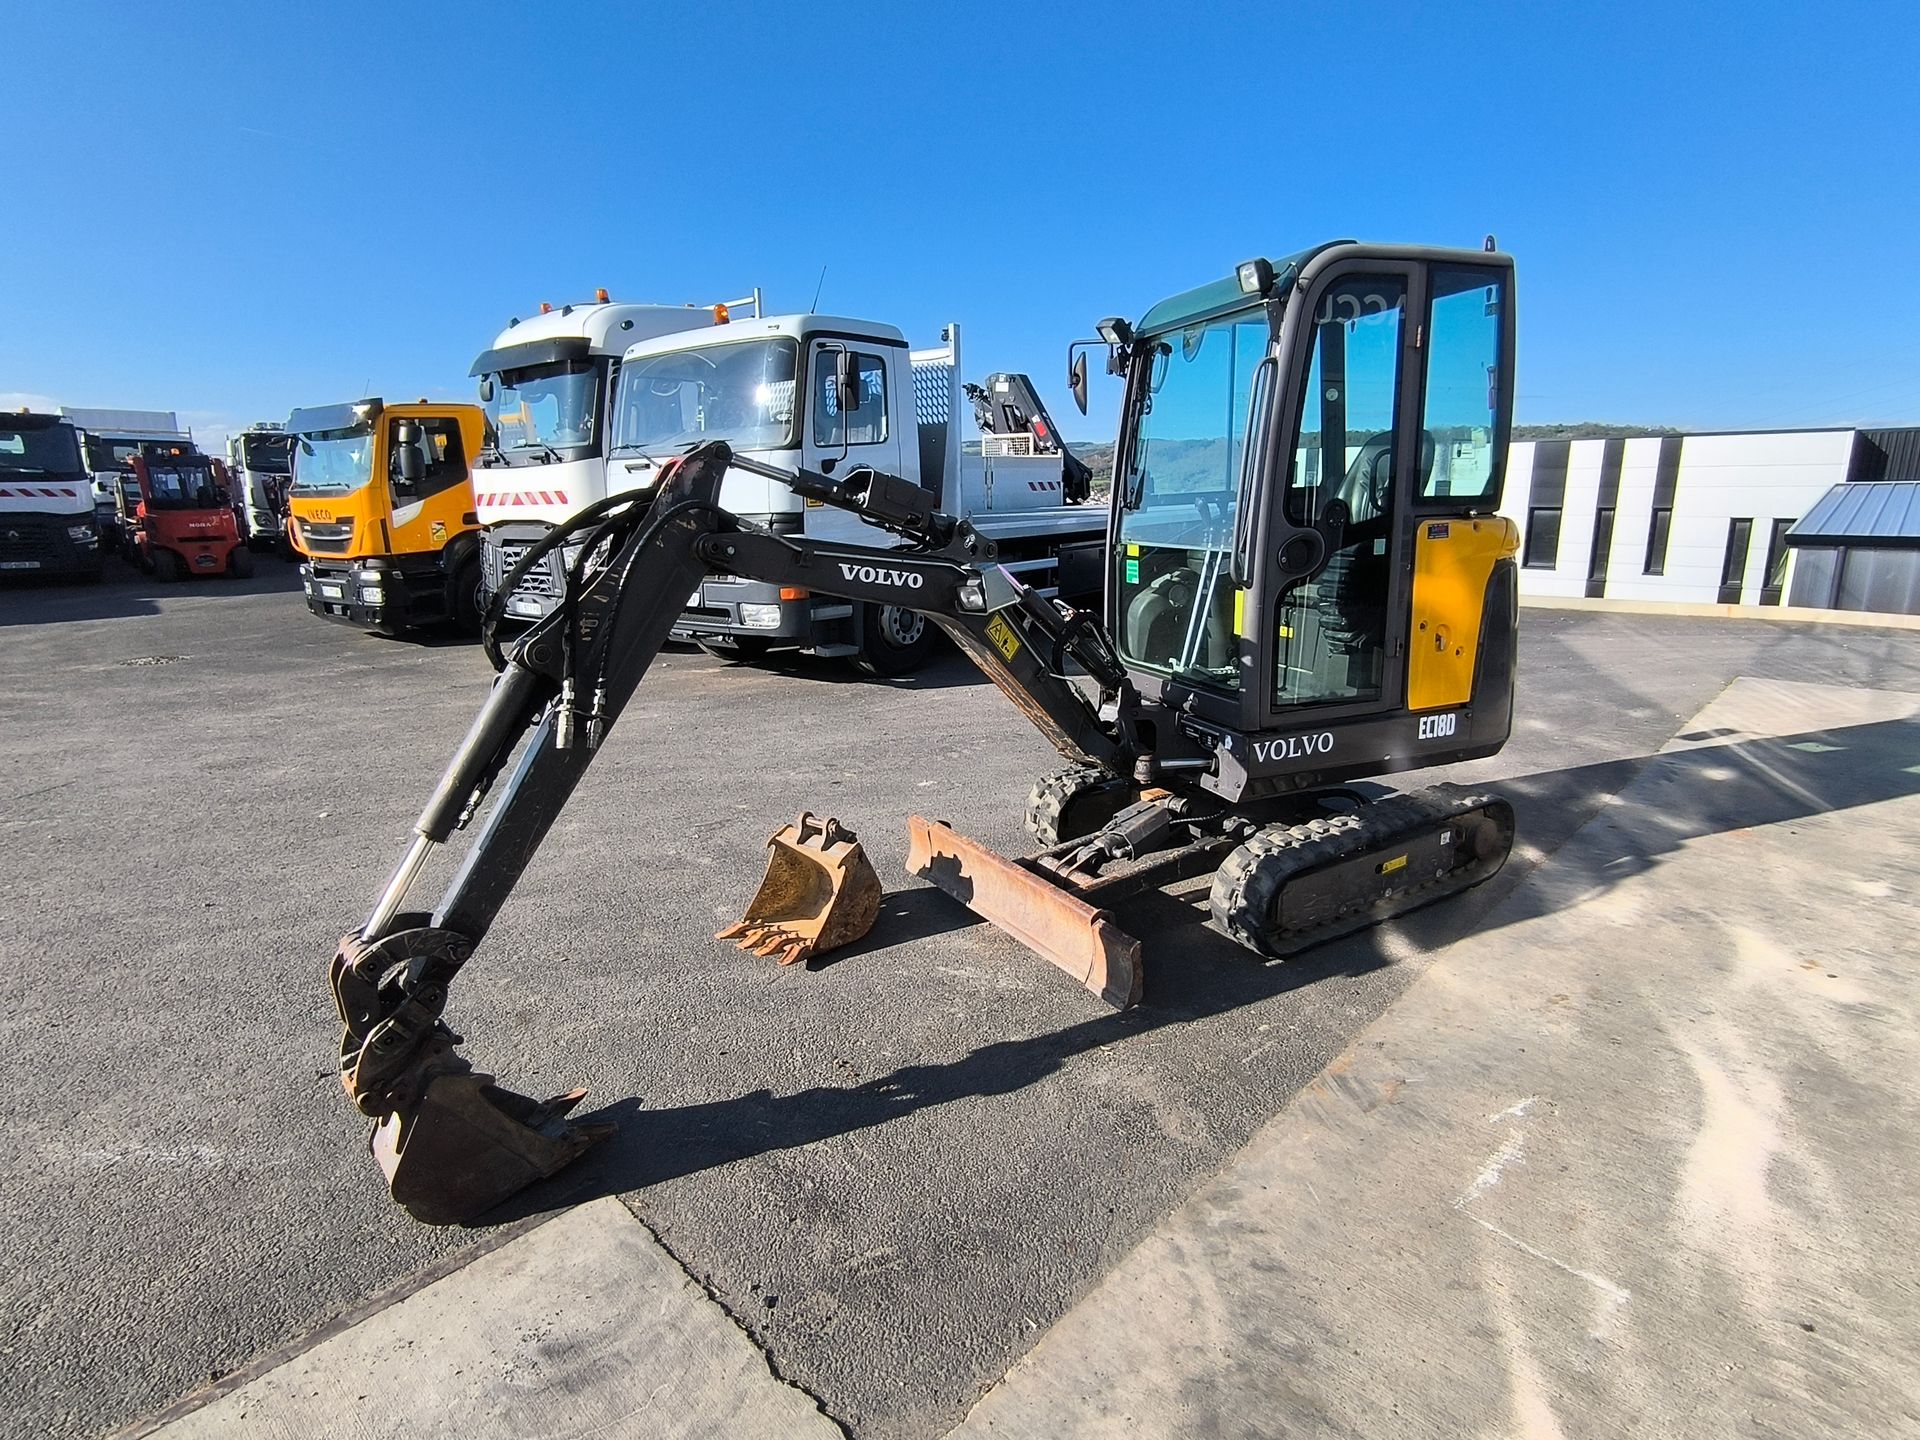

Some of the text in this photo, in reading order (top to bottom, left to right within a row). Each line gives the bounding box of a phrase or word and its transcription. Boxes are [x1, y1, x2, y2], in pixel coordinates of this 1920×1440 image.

[307, 509, 332, 521] IVECO
[838, 563, 923, 589] VOLVO
[1418, 713, 1456, 740] EC18D
[1253, 732, 1334, 763] VOLVO
